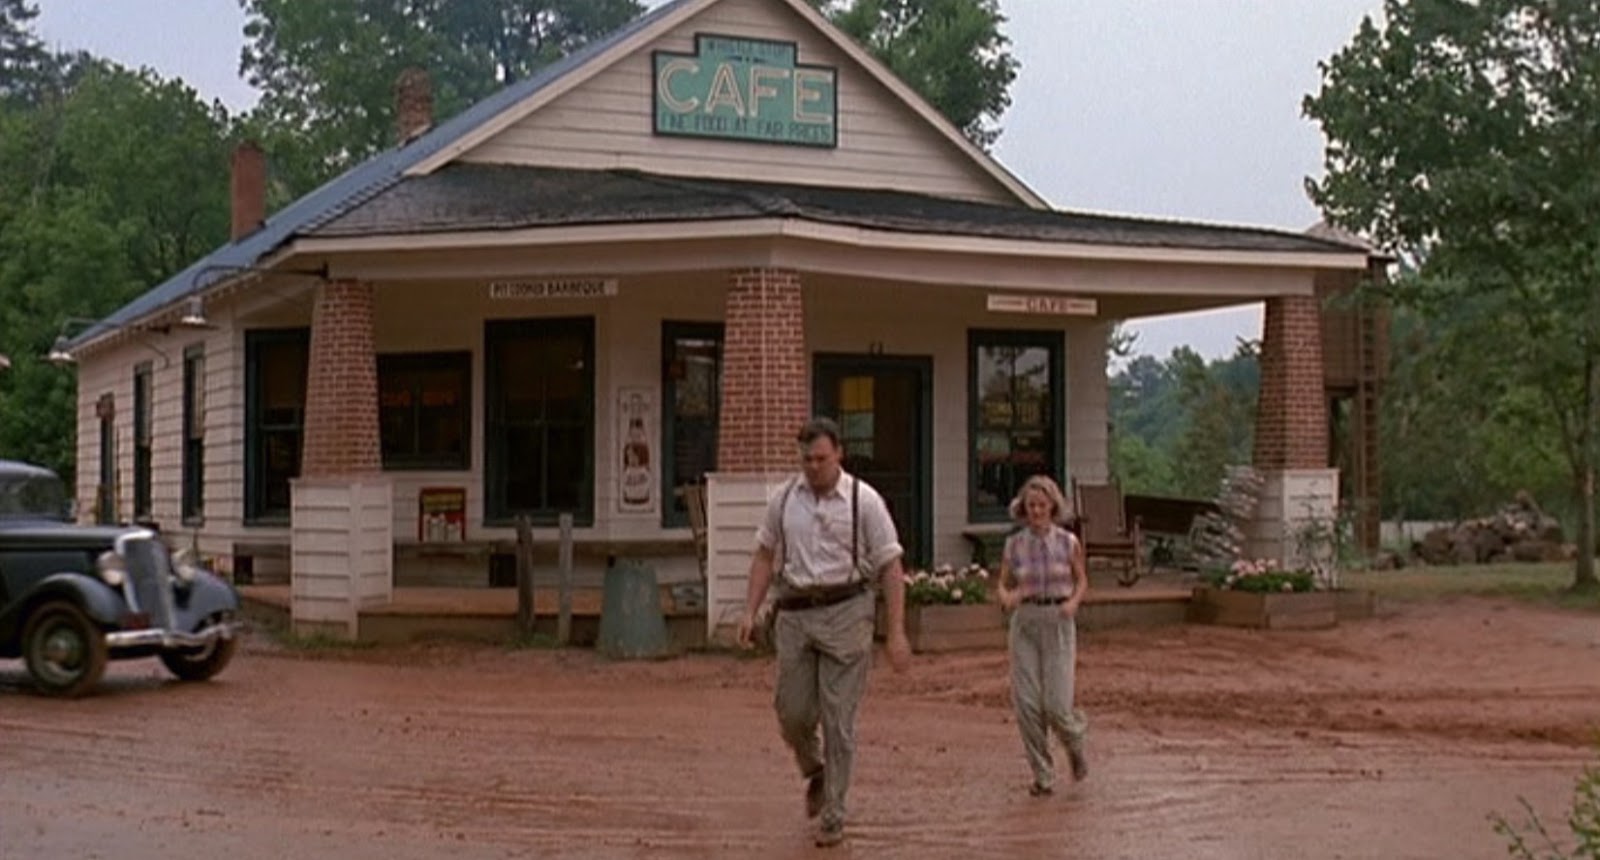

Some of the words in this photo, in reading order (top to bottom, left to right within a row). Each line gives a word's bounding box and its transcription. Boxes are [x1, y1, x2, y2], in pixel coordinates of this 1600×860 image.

[658, 59, 833, 123] CAFE
[694, 114, 728, 131] FOOD
[734, 116, 749, 132] AT
[1026, 297, 1068, 314] CAFE
